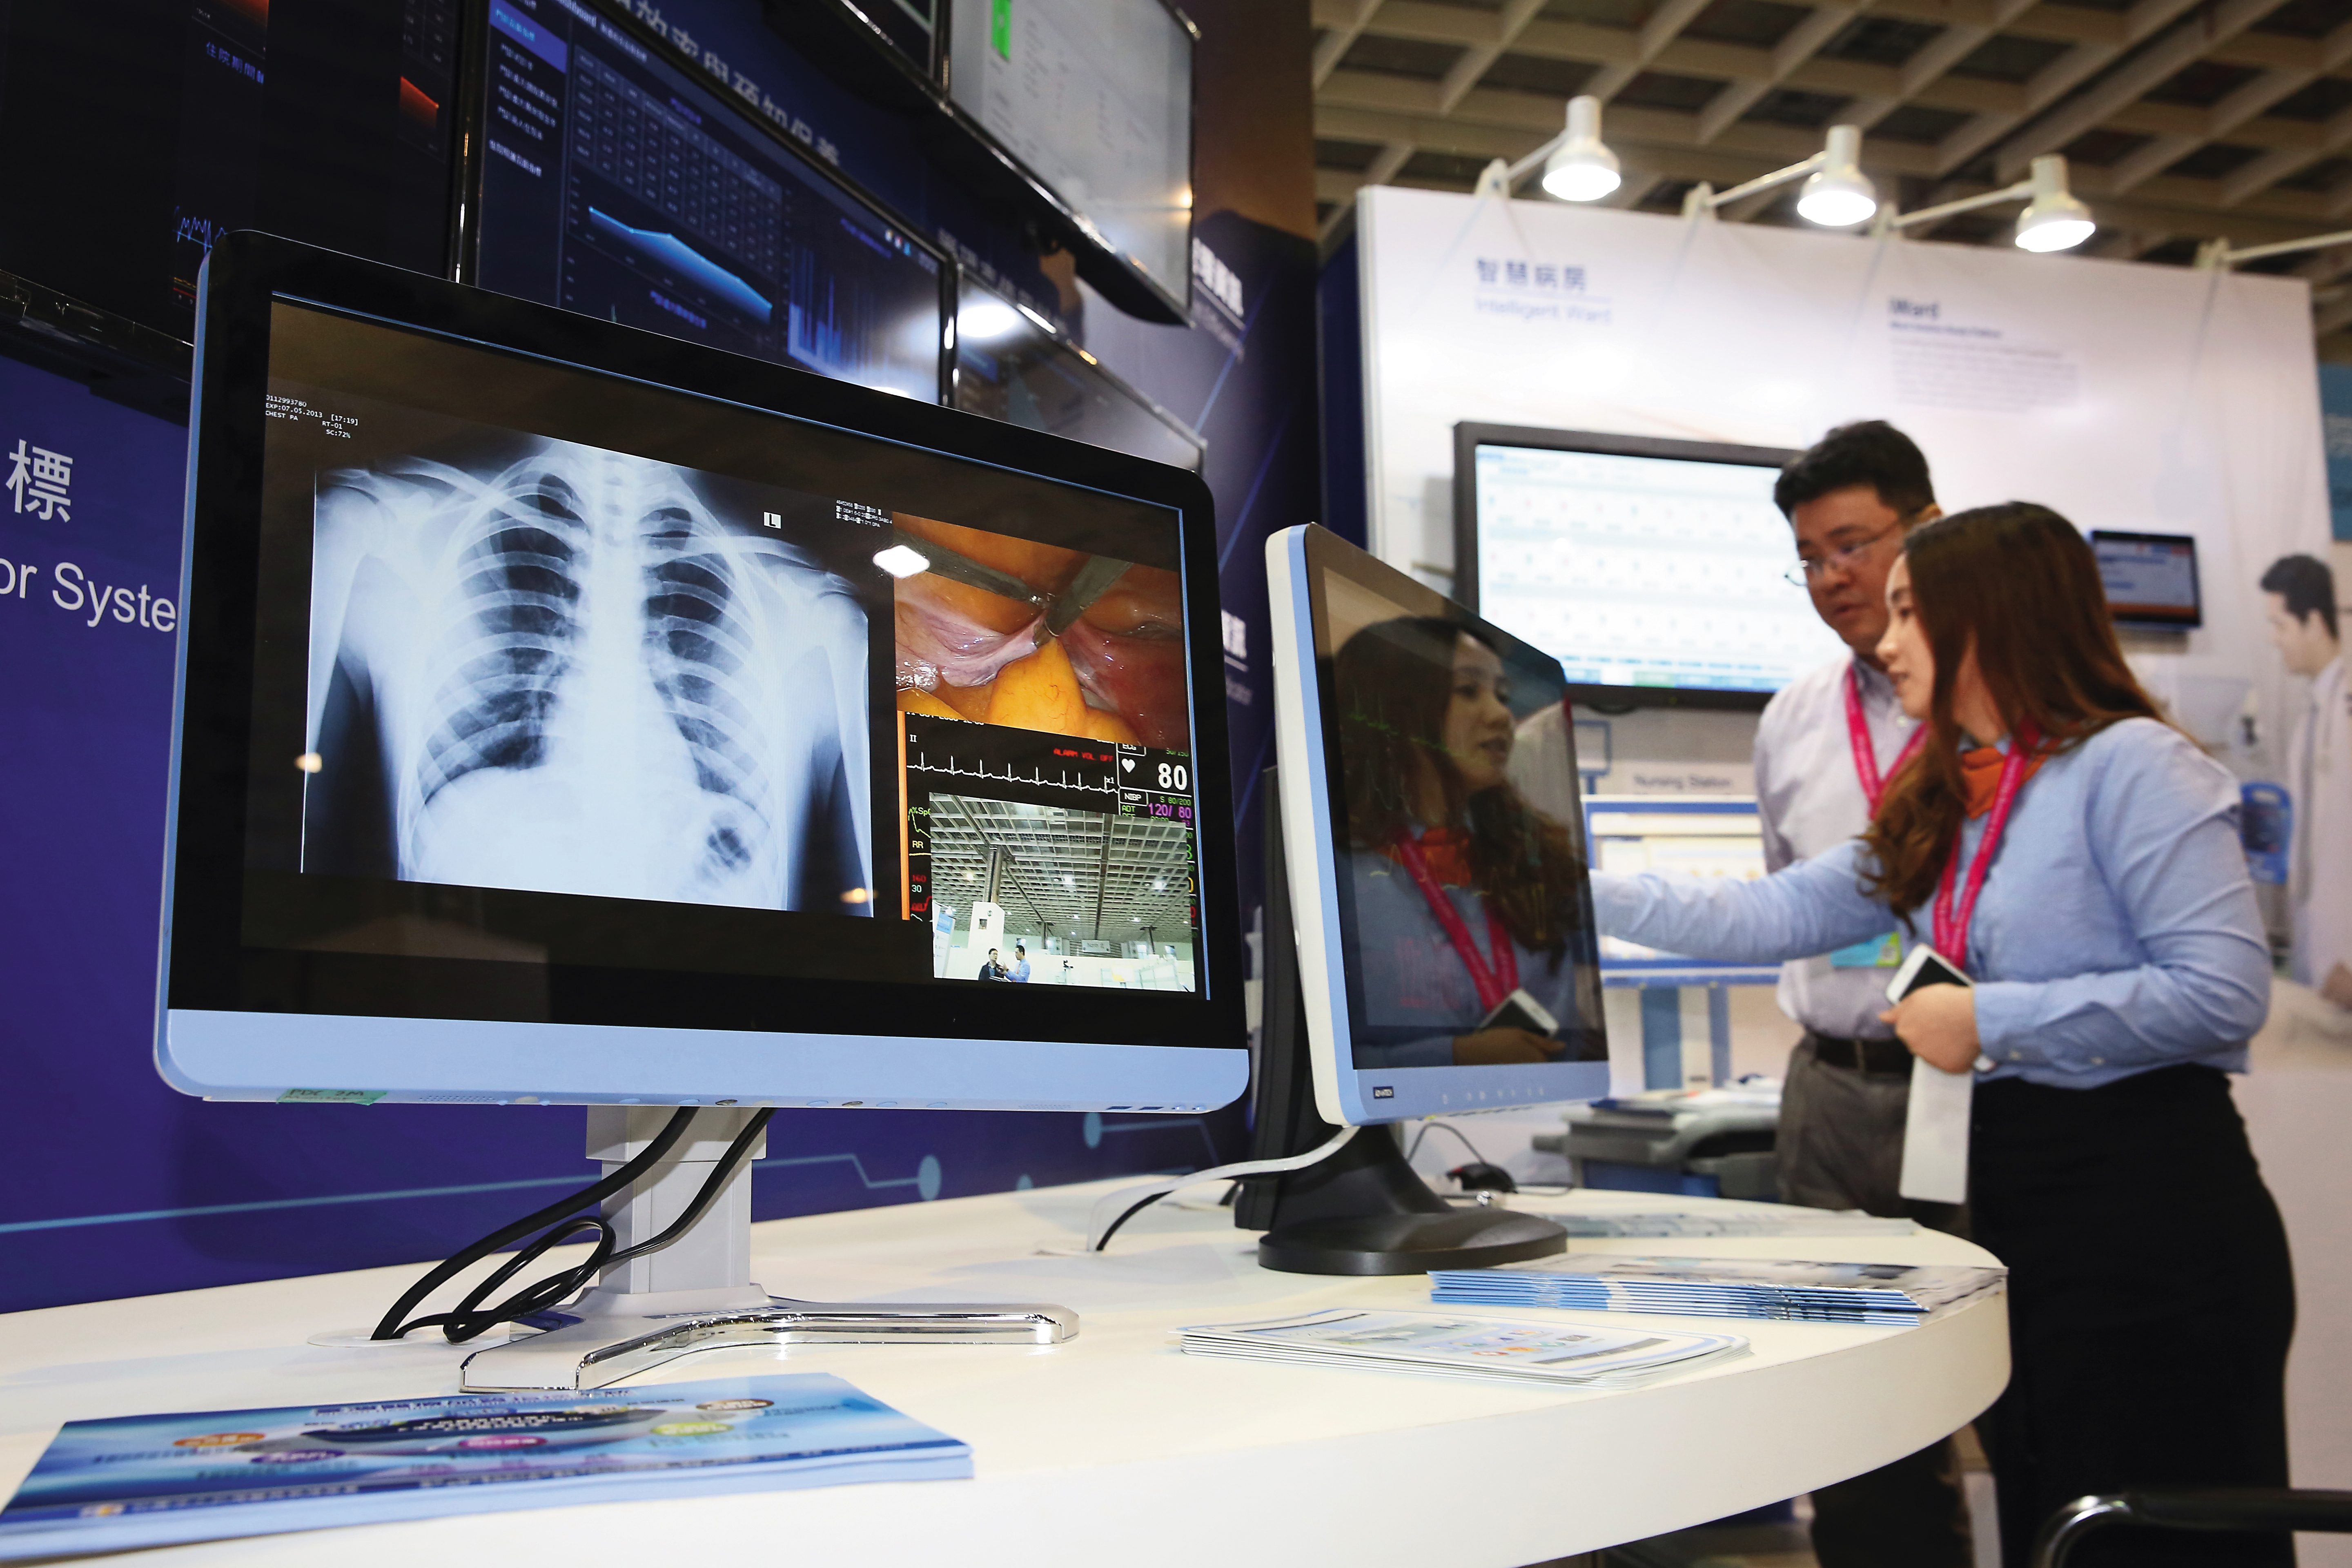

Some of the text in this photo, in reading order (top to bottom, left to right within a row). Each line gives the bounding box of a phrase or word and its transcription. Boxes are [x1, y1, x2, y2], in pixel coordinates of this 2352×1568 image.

[265, 410, 286, 419] CHEST
[322, 421, 343, 429] RT-01
[326, 429, 351, 439] SC:72%
[6, 439, 73, 523] 標
[1158, 763, 1187, 791] 80
[1124, 793, 1142, 801] NIBP
[1178, 806, 1192, 819] 80
[912, 840, 924, 849] RR
[911, 884, 922, 893] 30
